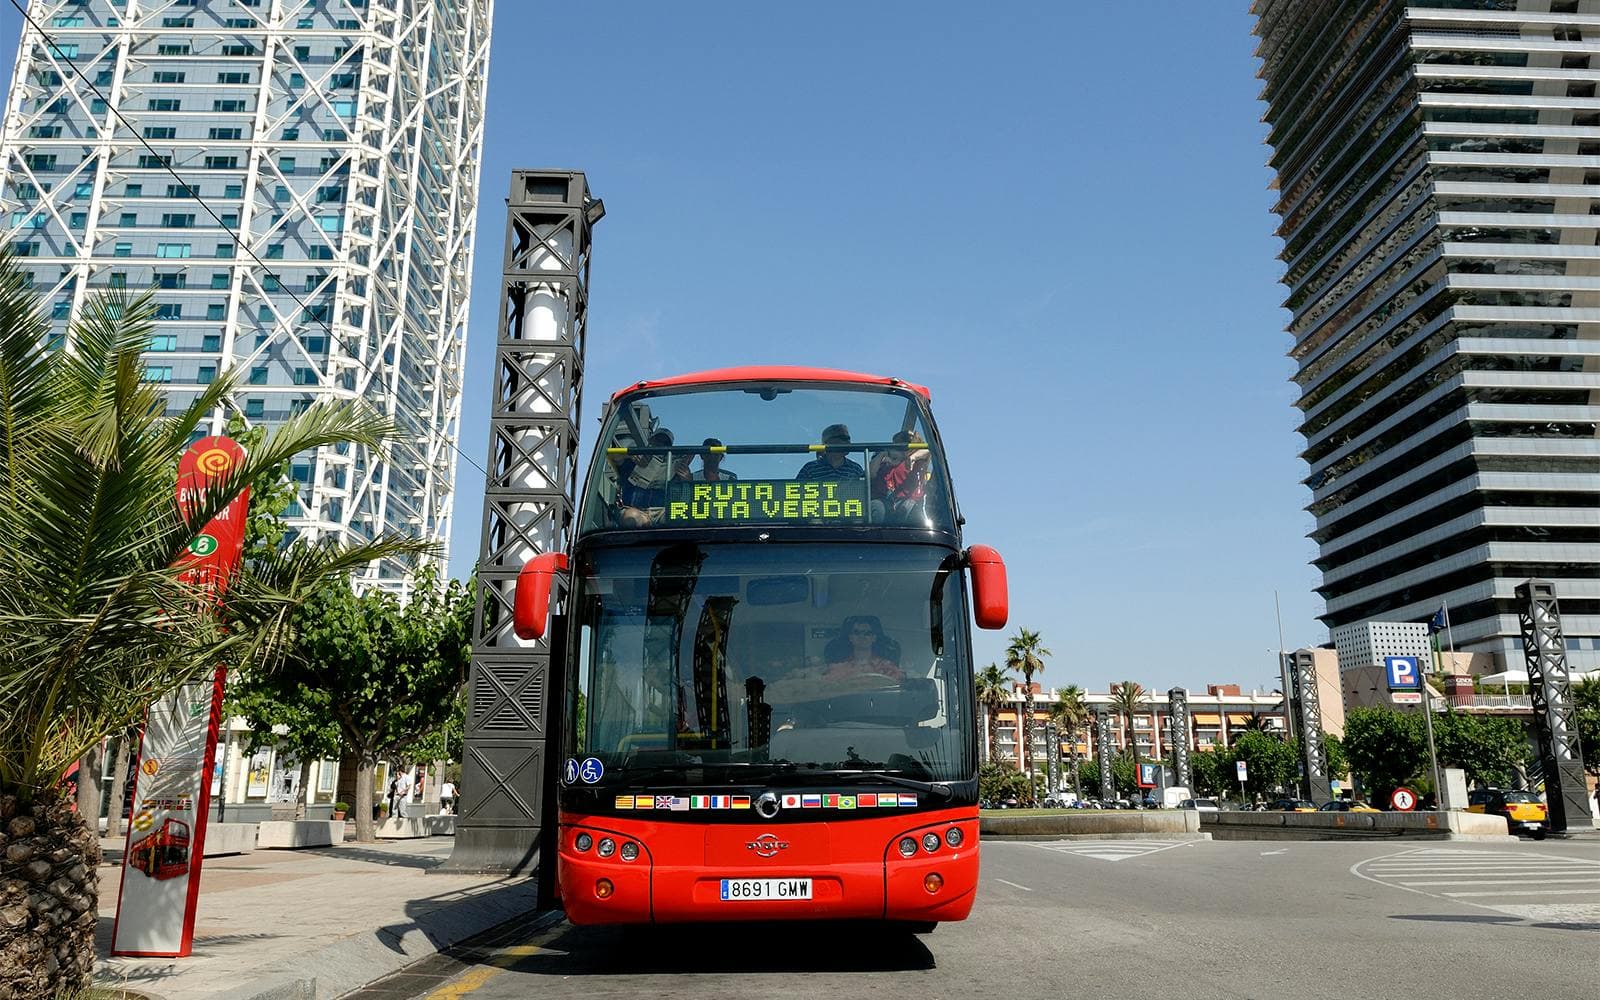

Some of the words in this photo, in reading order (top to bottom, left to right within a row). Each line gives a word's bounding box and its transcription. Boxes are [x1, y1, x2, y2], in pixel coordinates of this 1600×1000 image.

[694, 483, 773, 501] RUTA
[785, 483, 838, 499] EST
[670, 501, 750, 519] RUTA
[762, 499, 863, 518] VERDA
[1391, 659, 1412, 684] P
[732, 882, 771, 897] 8691
[778, 881, 808, 897] GMW
